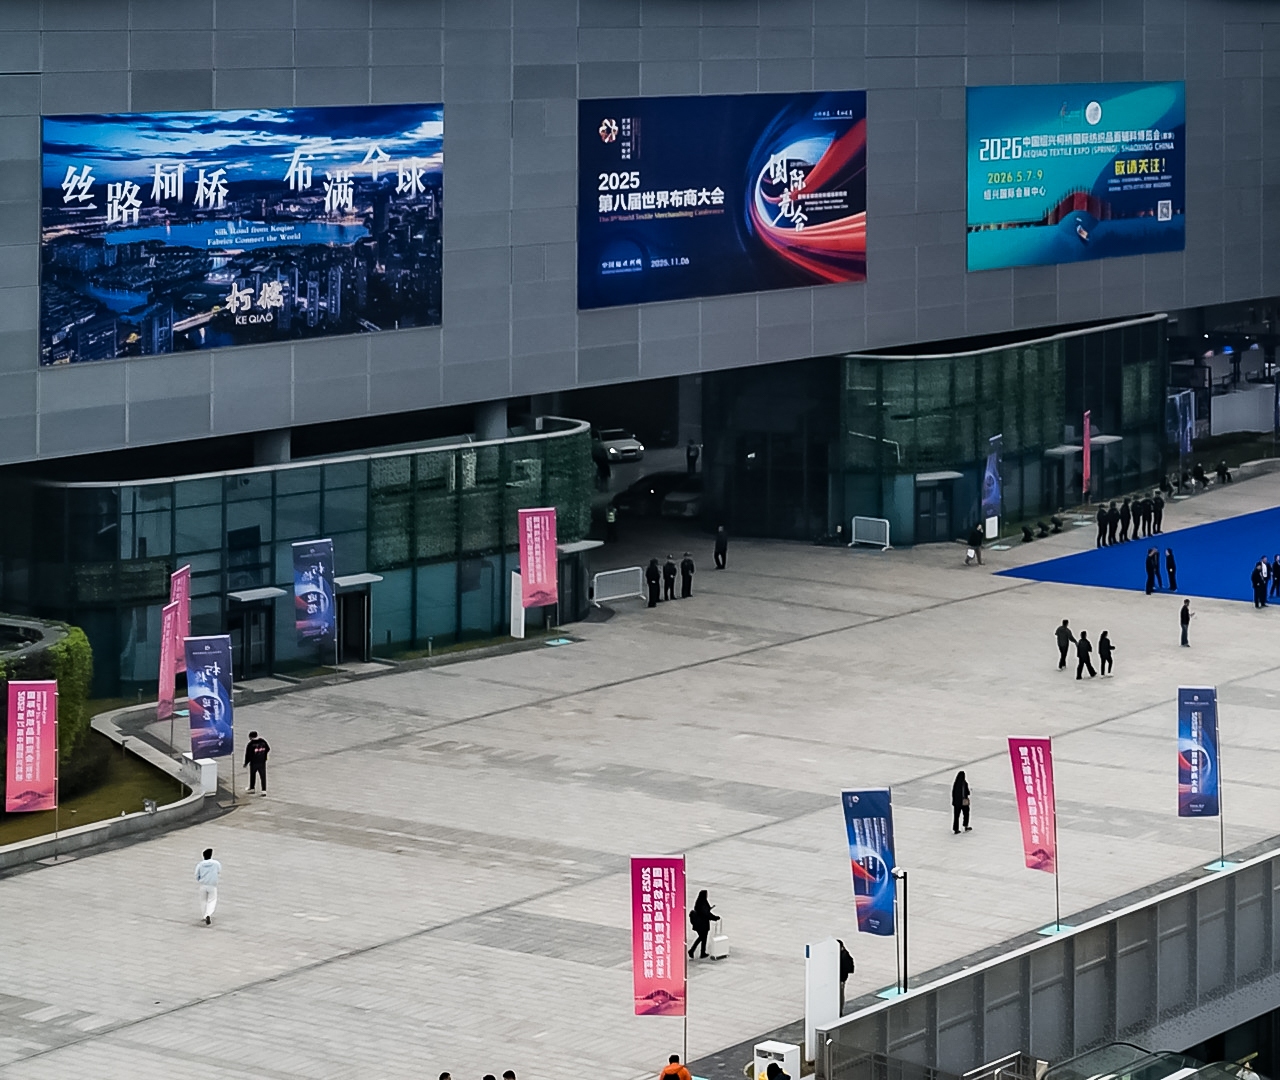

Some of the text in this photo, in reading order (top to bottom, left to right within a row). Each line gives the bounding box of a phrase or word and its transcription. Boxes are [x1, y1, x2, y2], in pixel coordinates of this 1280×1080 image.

[980, 136, 1022, 161] 2026
[1049, 147, 1072, 156] TEXTILE
[1074, 146, 1090, 155] EXPO
[1154, 142, 1175, 151] CHINA
[598, 171, 640, 191] 2025
[61, 163, 228, 225] 丝路柯桥
[598, 186, 725, 213] 第八届世界布商大会
